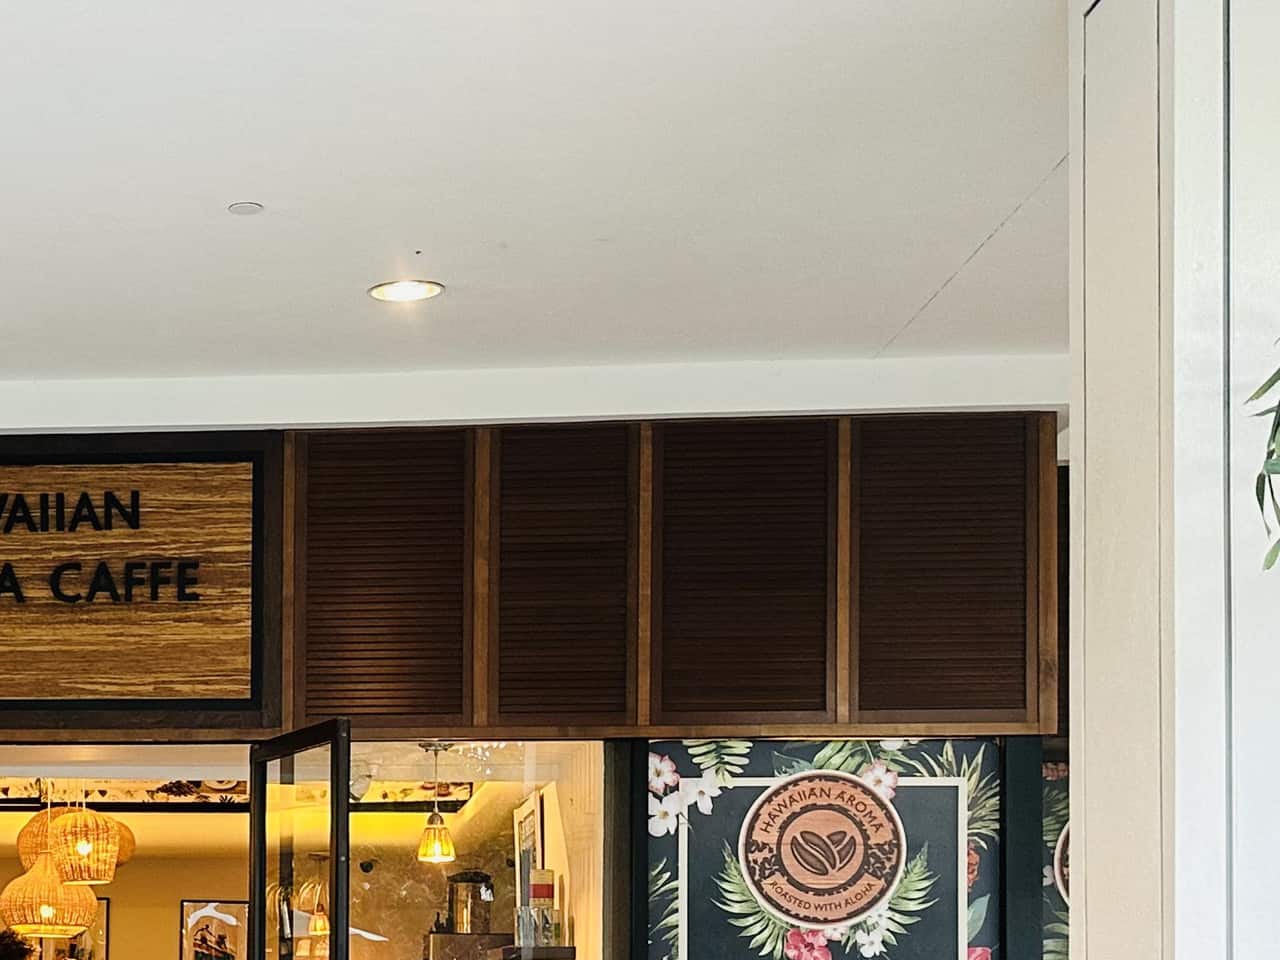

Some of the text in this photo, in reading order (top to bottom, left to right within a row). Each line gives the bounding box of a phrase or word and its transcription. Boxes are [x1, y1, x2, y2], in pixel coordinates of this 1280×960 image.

[48, 560, 201, 603] CAFFE
[759, 786, 885, 835] HAWAIIAN AROMA
[769, 879, 877, 913] ROASTED WITH ALOHA
